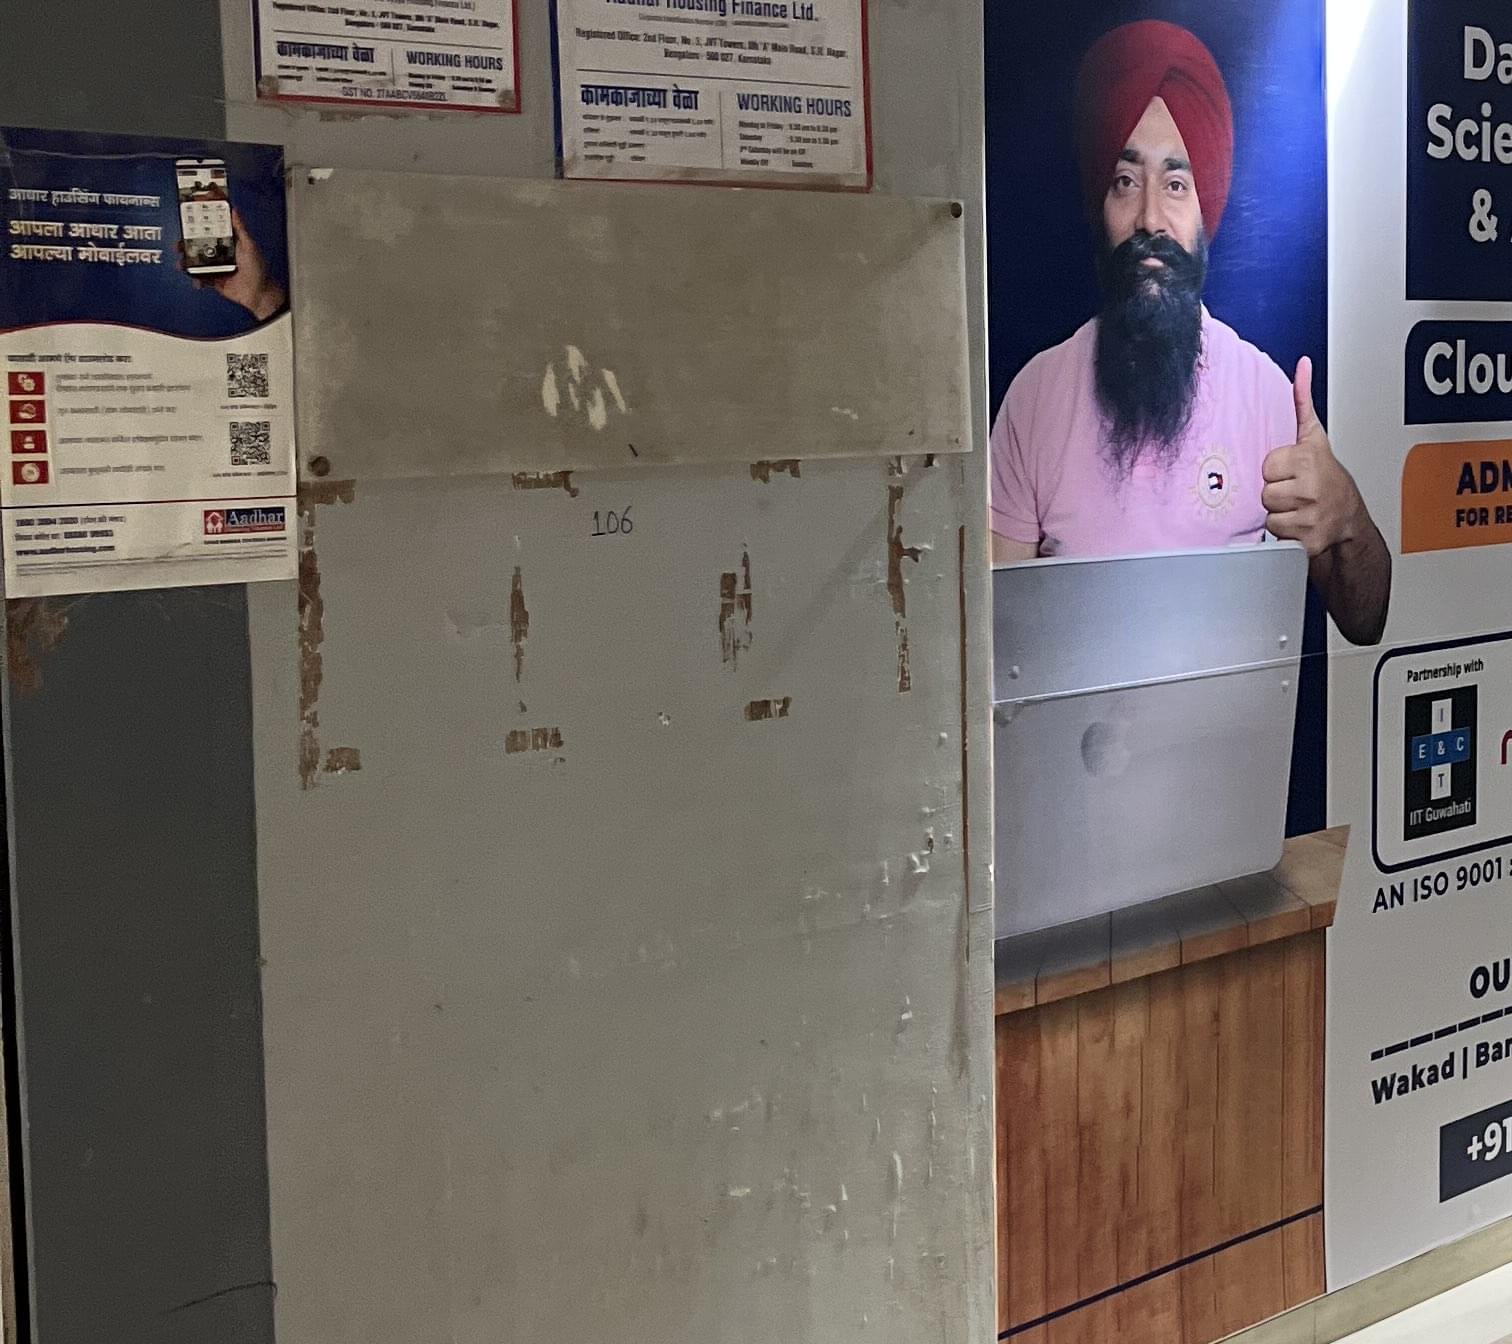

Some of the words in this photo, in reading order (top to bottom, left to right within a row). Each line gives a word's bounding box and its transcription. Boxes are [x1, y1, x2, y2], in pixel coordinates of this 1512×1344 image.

[792, 0, 819, 22] Ltd.
[407, 51, 461, 69] WORKING
[465, 54, 504, 71] HOURS
[580, 84, 667, 109] कामकाजाच्या
[672, 83, 699, 110] वेळा
[736, 93, 802, 114] WORKING
[806, 97, 851, 117] HOURS
[8, 188, 48, 201] आधार
[104, 193, 160, 207] फायनान्स
[1468, 188, 1498, 243] &
[9, 220, 64, 237] आपला
[68, 222, 119, 239] आधार
[123, 225, 162, 240] आता
[10, 244, 73, 261] आपल्या
[77, 241, 163, 266] मोबाईलवर
[228, 509, 284, 528] Aadhar
[591, 505, 633, 537] 106
[1455, 508, 1489, 528] FOR
[1407, 663, 1461, 683] Partnership
[1464, 658, 1484, 674] with
[1418, 744, 1427, 758] E
[1437, 741, 1446, 755] &
[1456, 737, 1464, 751] C
[1410, 809, 1424, 826] IIT
[1425, 798, 1471, 822] Guwahati
[1372, 882, 1404, 913] AN
[1413, 872, 1449, 902] ISO
[1456, 858, 1502, 890] 9001
[1371, 1052, 1455, 1105] Wakad
